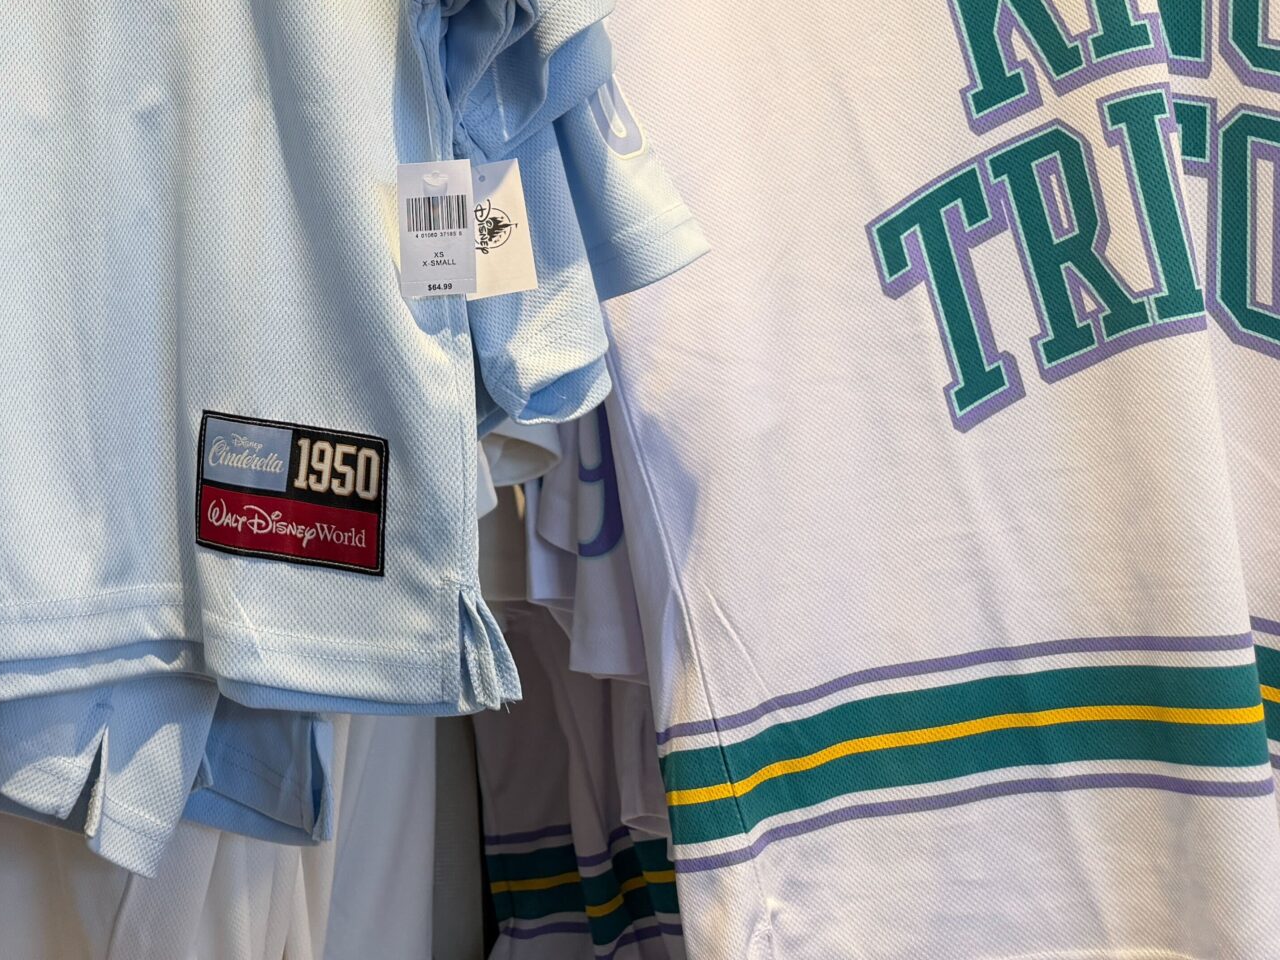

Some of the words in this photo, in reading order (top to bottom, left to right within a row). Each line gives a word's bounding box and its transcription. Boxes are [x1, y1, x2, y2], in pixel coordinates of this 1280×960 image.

[422, 259, 456, 267] X-SMALL
[428, 283, 453, 291] $64.99
[208, 435, 284, 473] Cinderella
[294, 438, 380, 501] 1950
[315, 523, 366, 548] World
